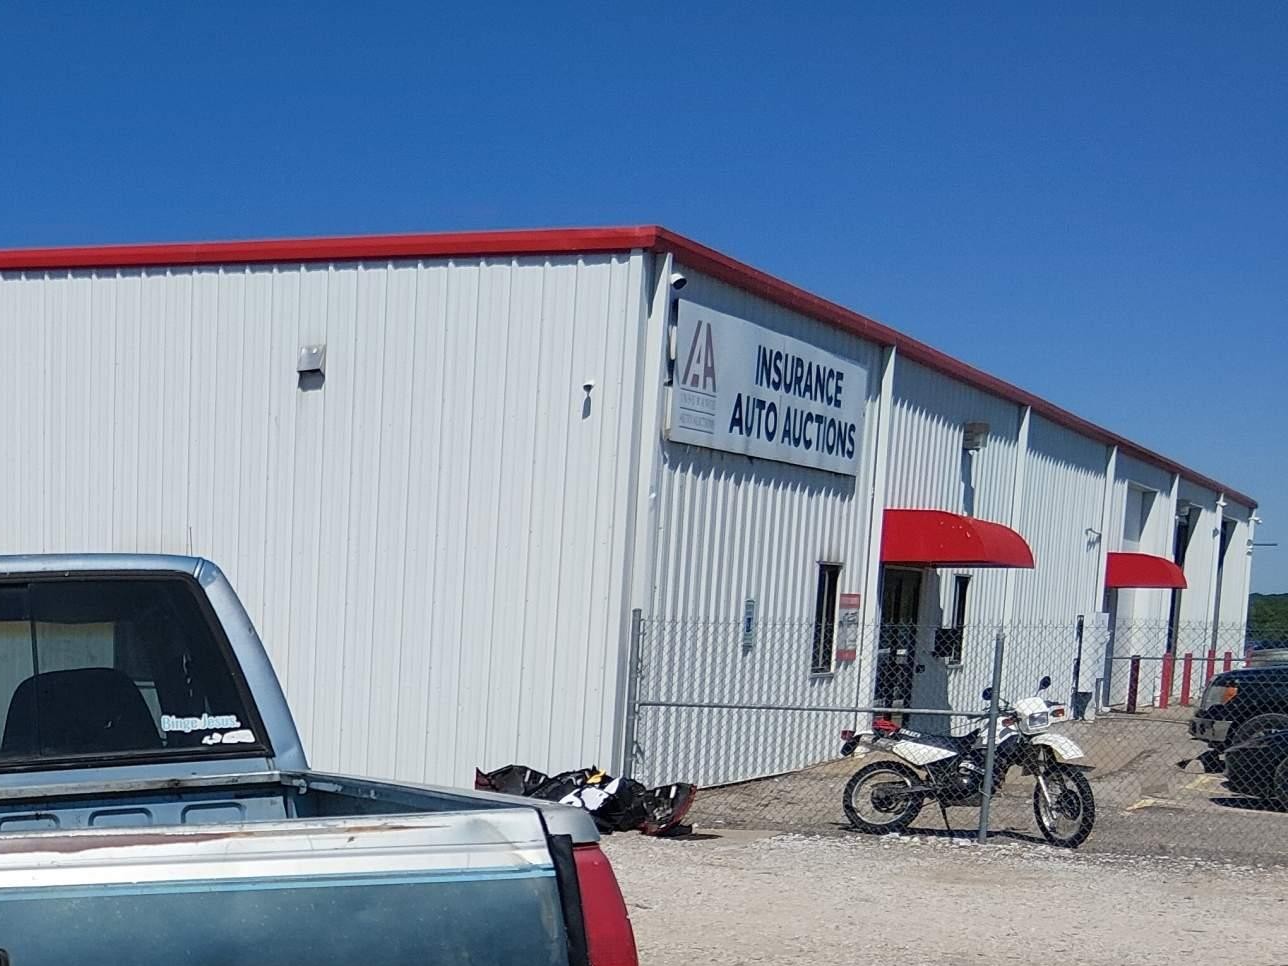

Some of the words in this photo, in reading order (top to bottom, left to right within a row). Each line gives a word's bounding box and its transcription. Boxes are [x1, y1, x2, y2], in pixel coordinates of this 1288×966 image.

[755, 345, 844, 408] INSURANCE
[729, 393, 777, 442] AUTO
[781, 407, 856, 459] AUCTIONS
[161, 715, 200, 733] Binge
